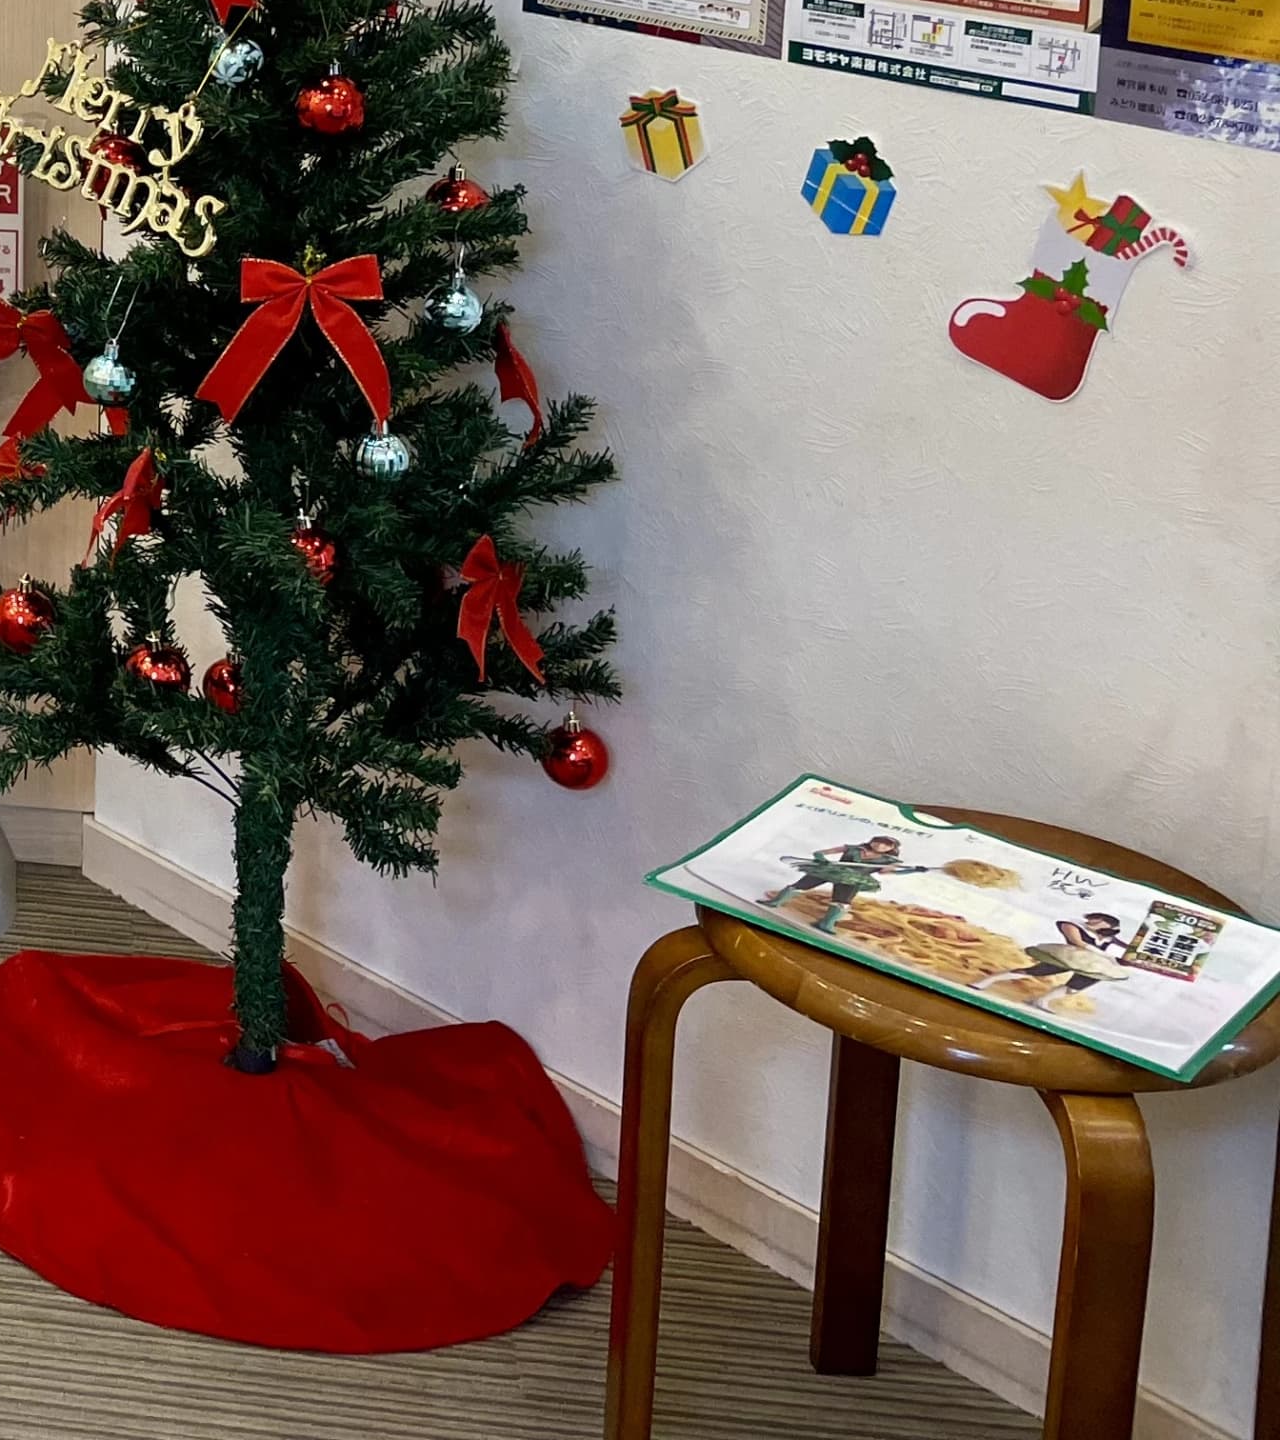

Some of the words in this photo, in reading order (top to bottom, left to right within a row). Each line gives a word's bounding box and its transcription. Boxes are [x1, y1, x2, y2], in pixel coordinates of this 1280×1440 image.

[21, 37, 203, 167] Merry
[801, 48, 928, 81] ヨモギヤ楽器株式会社
